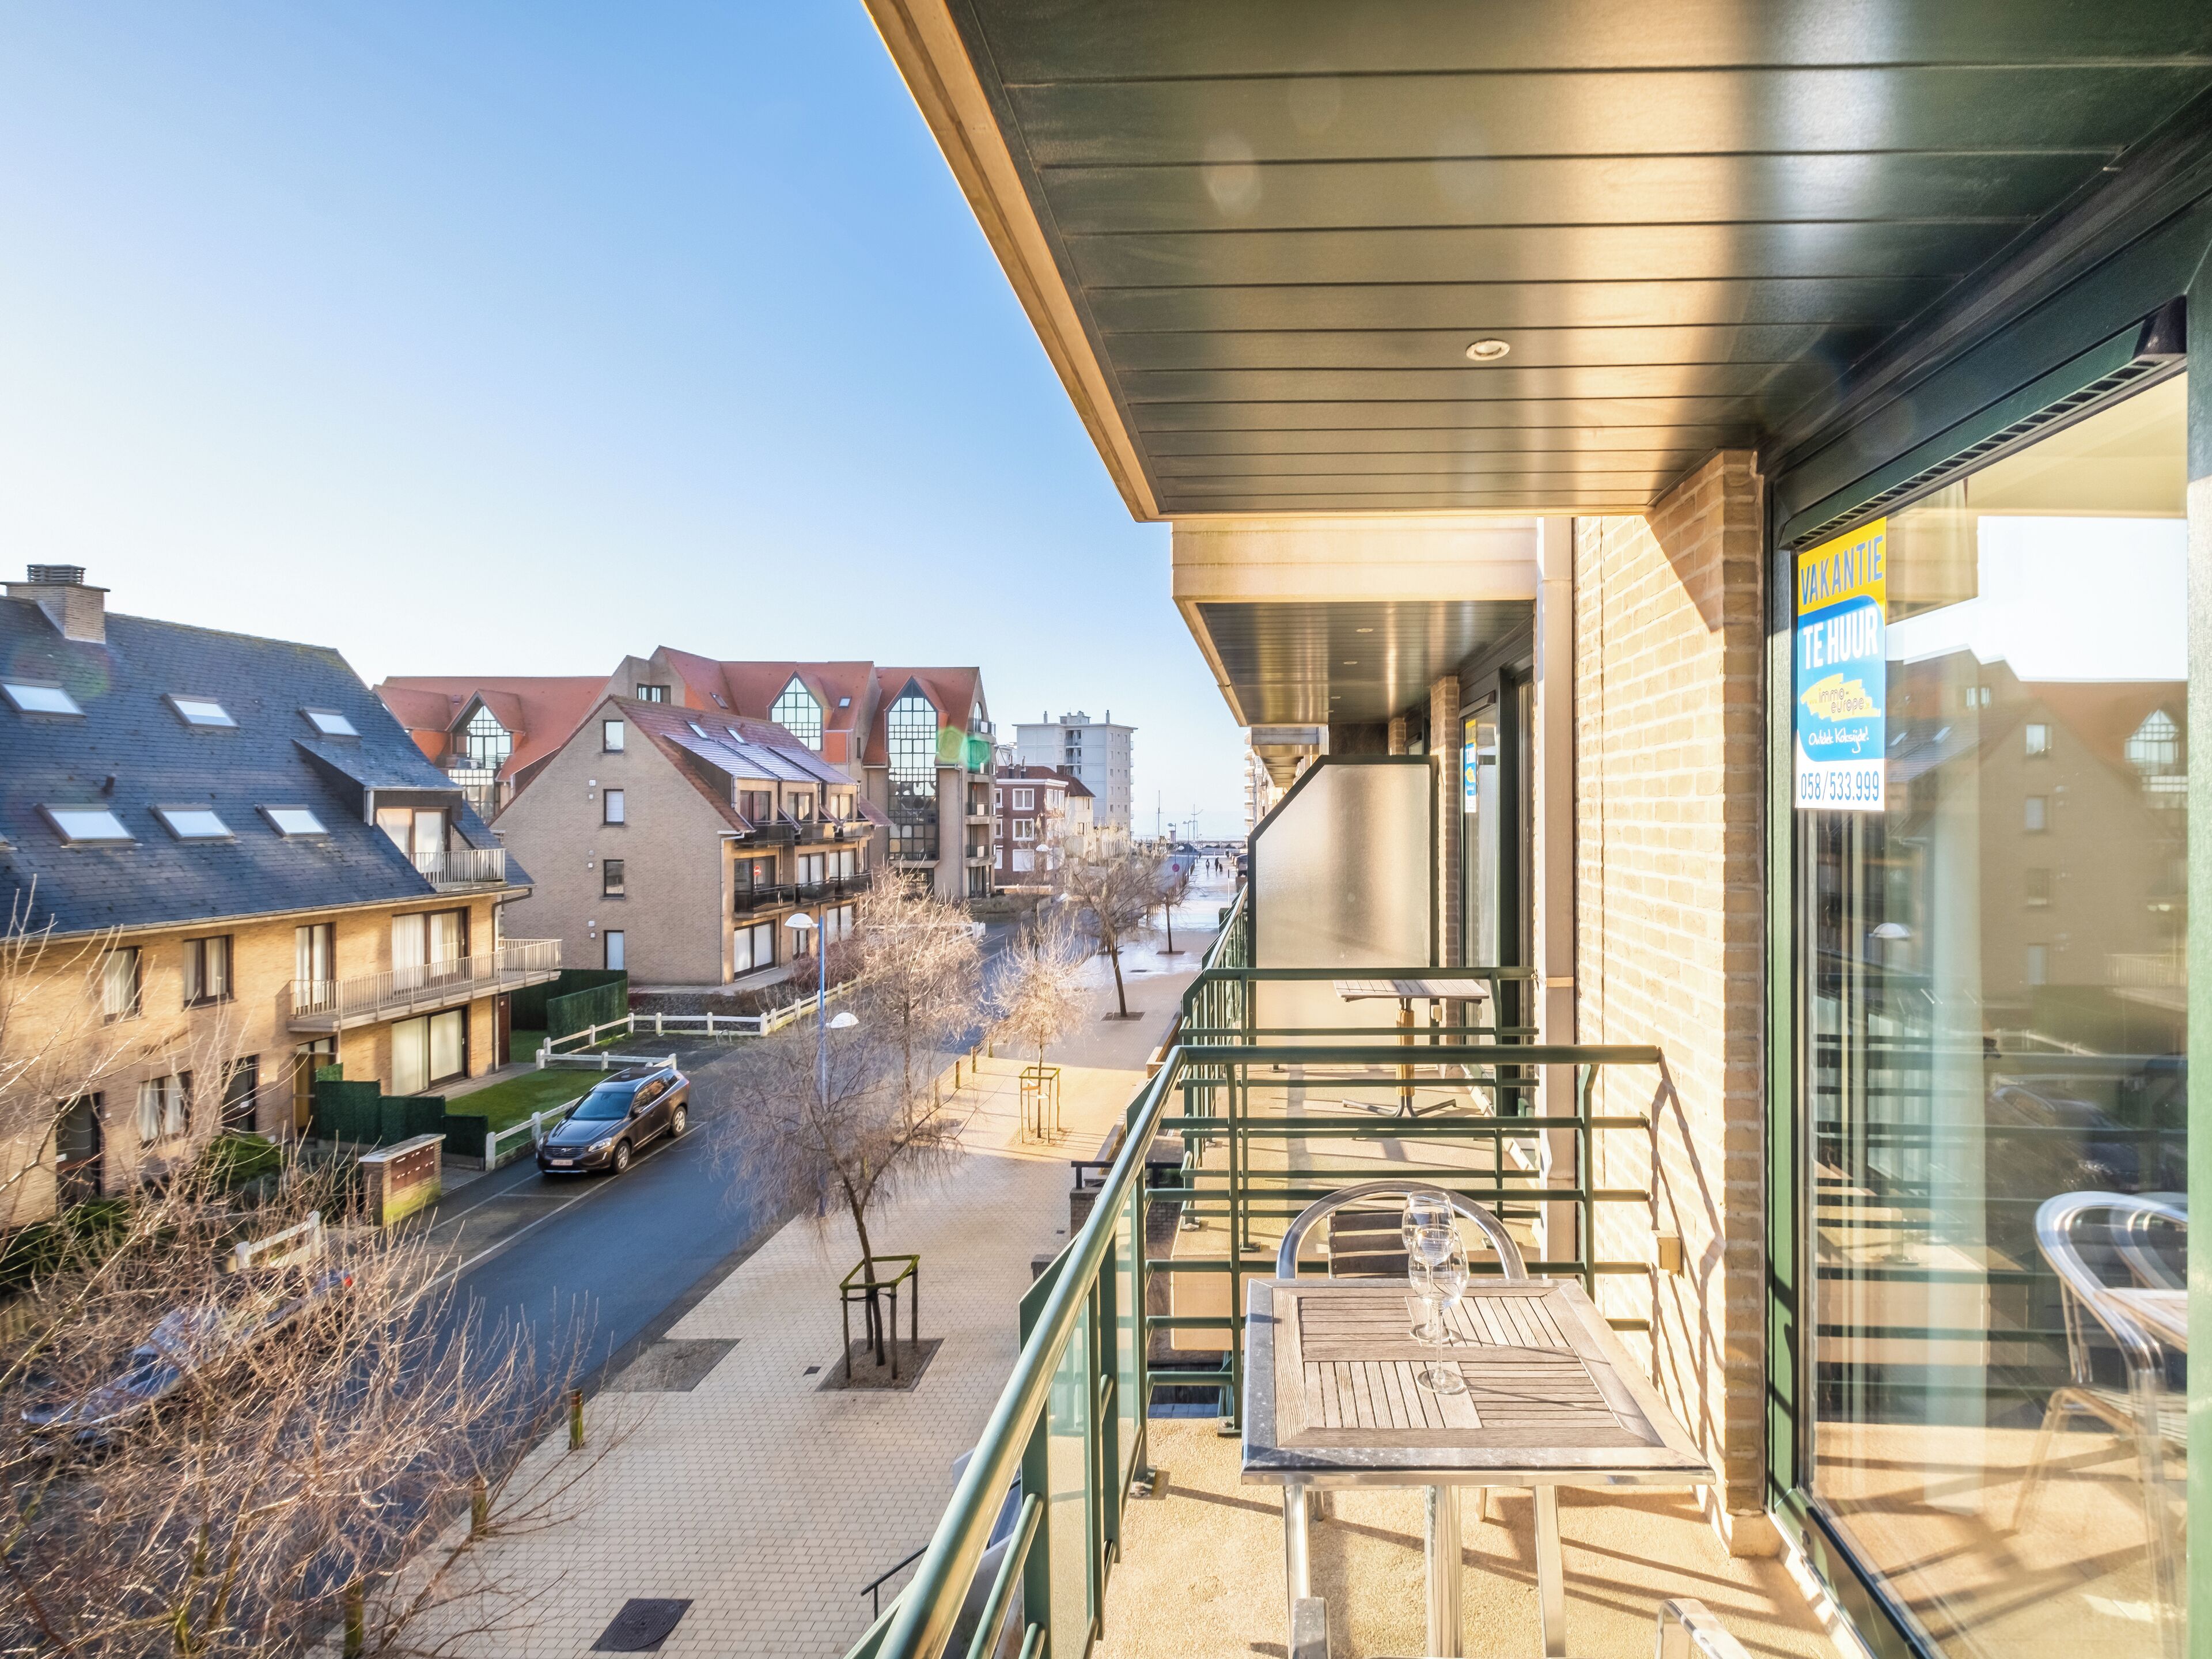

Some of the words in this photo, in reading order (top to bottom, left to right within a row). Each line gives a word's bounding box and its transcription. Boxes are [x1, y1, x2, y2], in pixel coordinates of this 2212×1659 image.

[1801, 535, 1883, 605] VAKANTIE
[1803, 622, 1824, 669] TE
[1827, 607, 1878, 664] HUUR
[1809, 728, 1834, 745] Ontdek
[1801, 771, 1879, 801] 058/533.999
